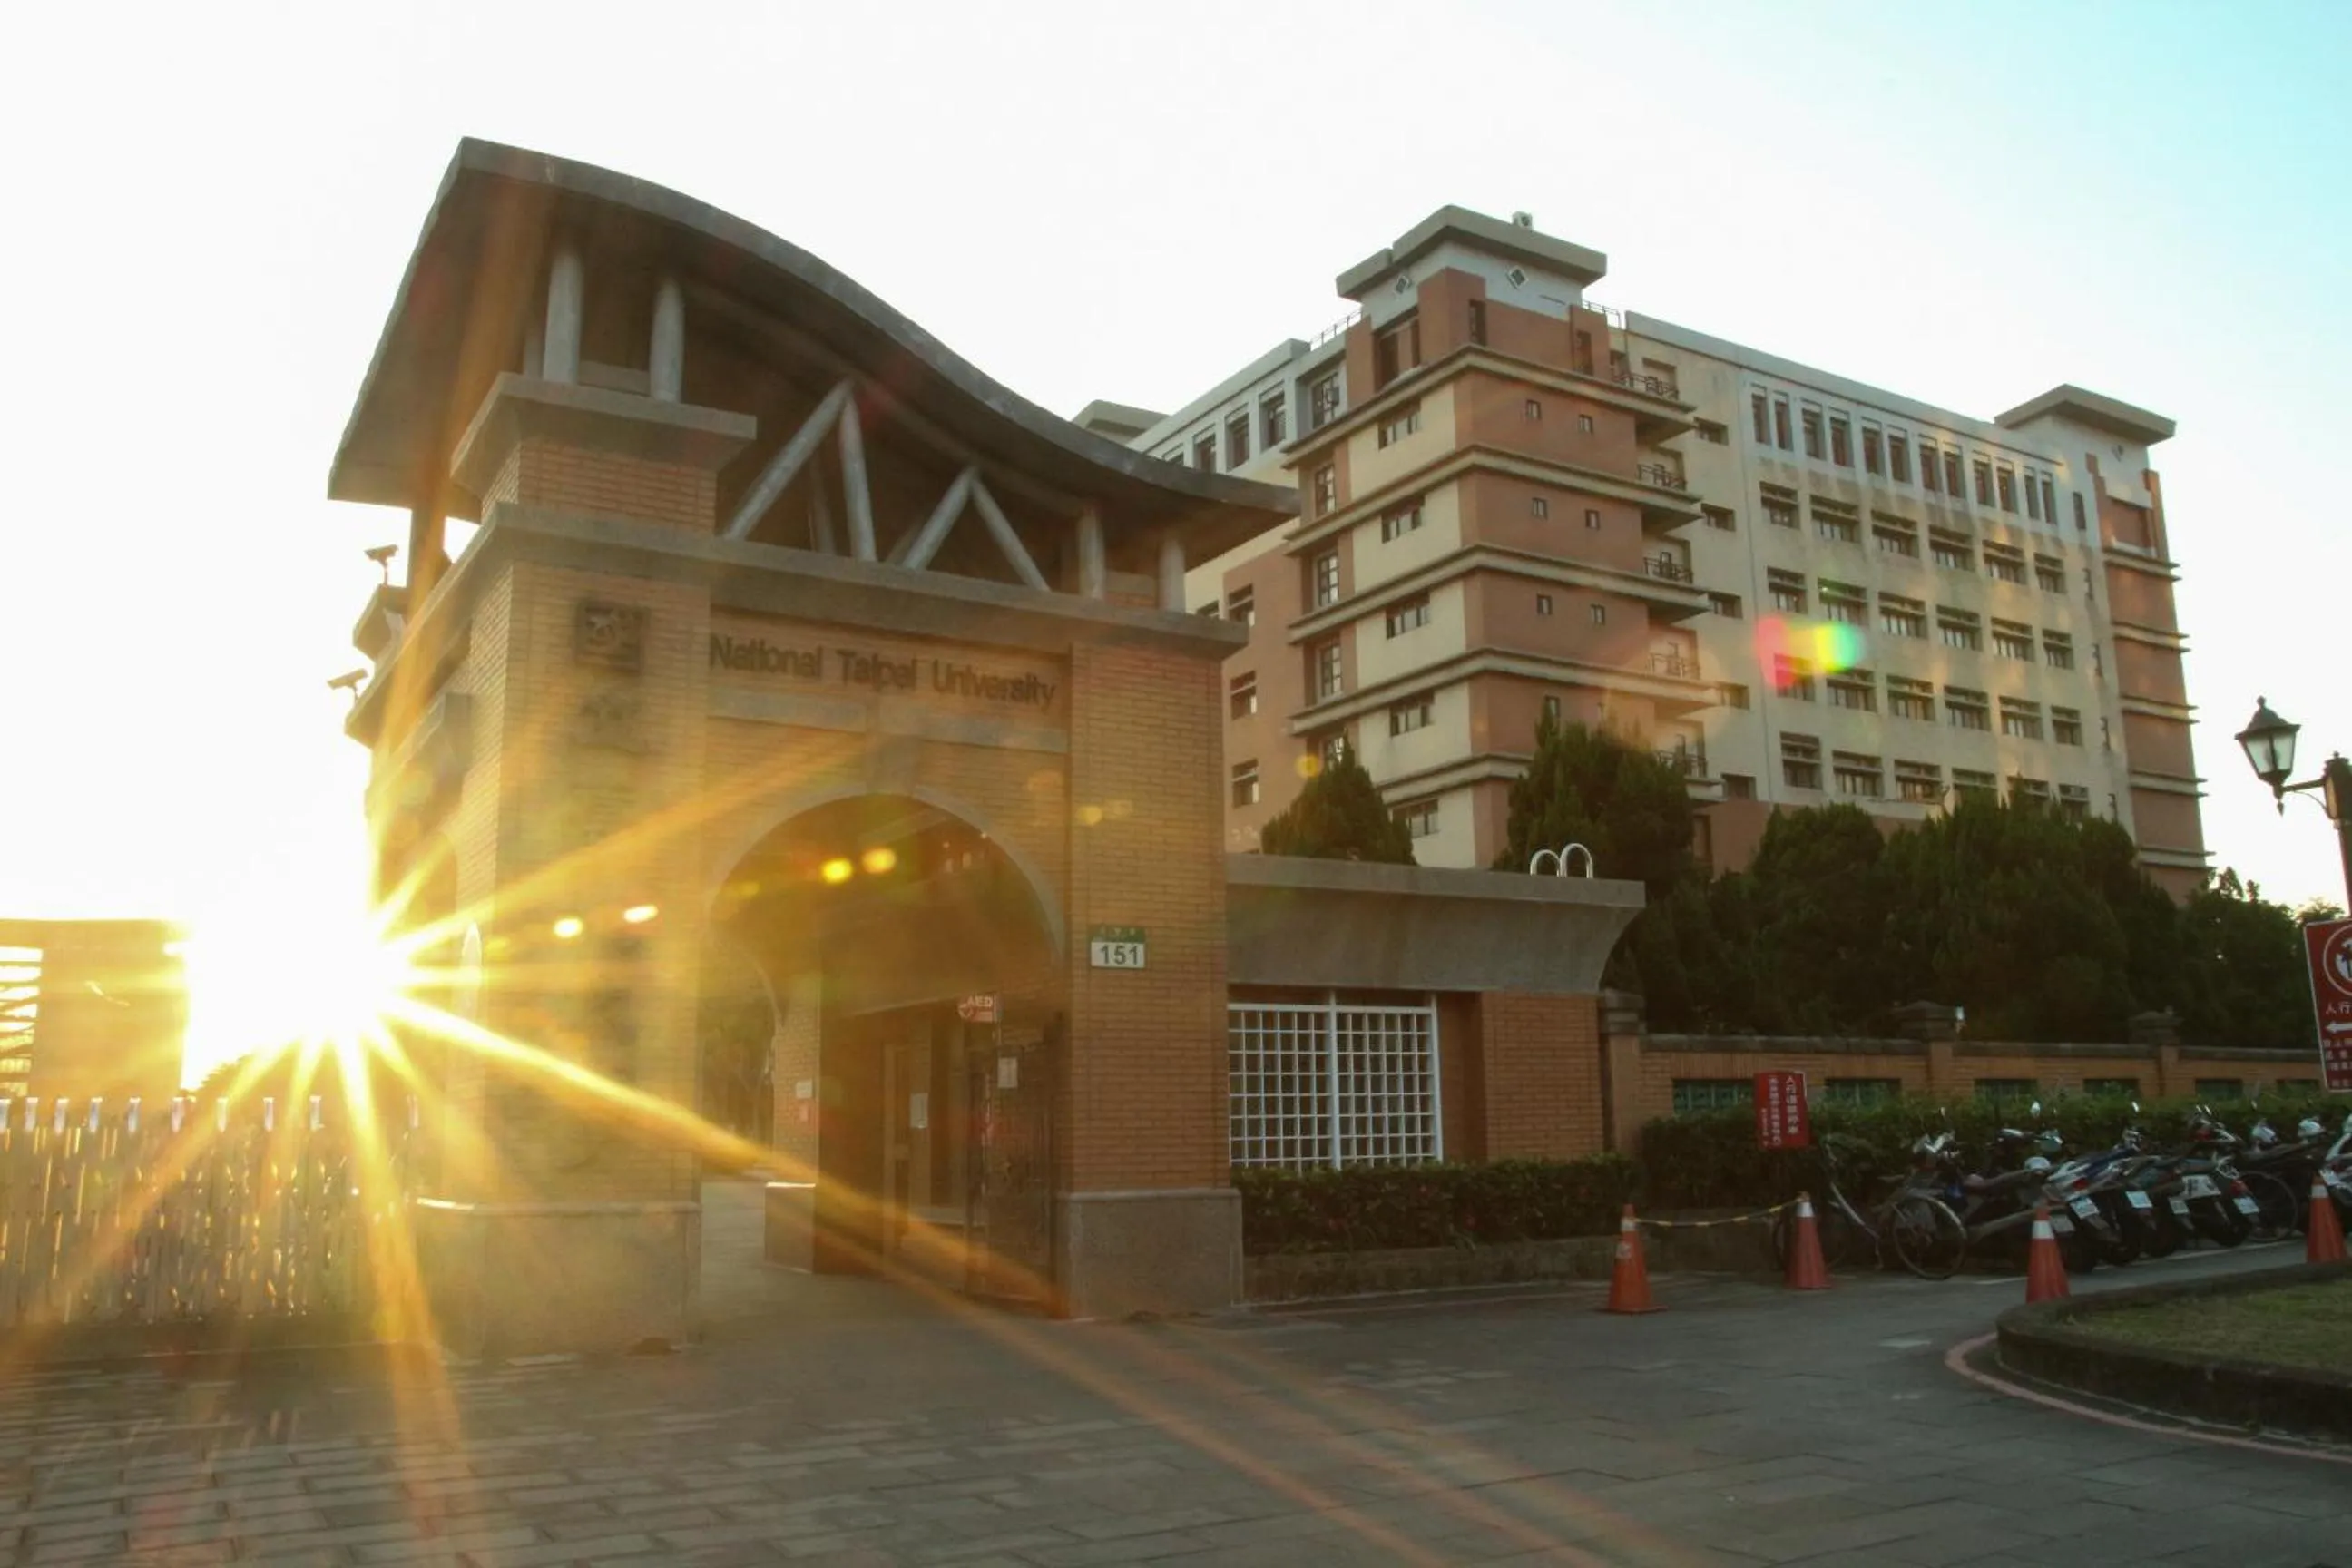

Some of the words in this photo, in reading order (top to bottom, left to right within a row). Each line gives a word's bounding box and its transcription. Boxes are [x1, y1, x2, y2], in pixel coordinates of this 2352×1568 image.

[710, 636, 822, 680] National
[836, 648, 916, 692] Taipei
[933, 659, 1057, 711] University
[1100, 945, 1138, 965] 151
[967, 995, 993, 1007] AED
